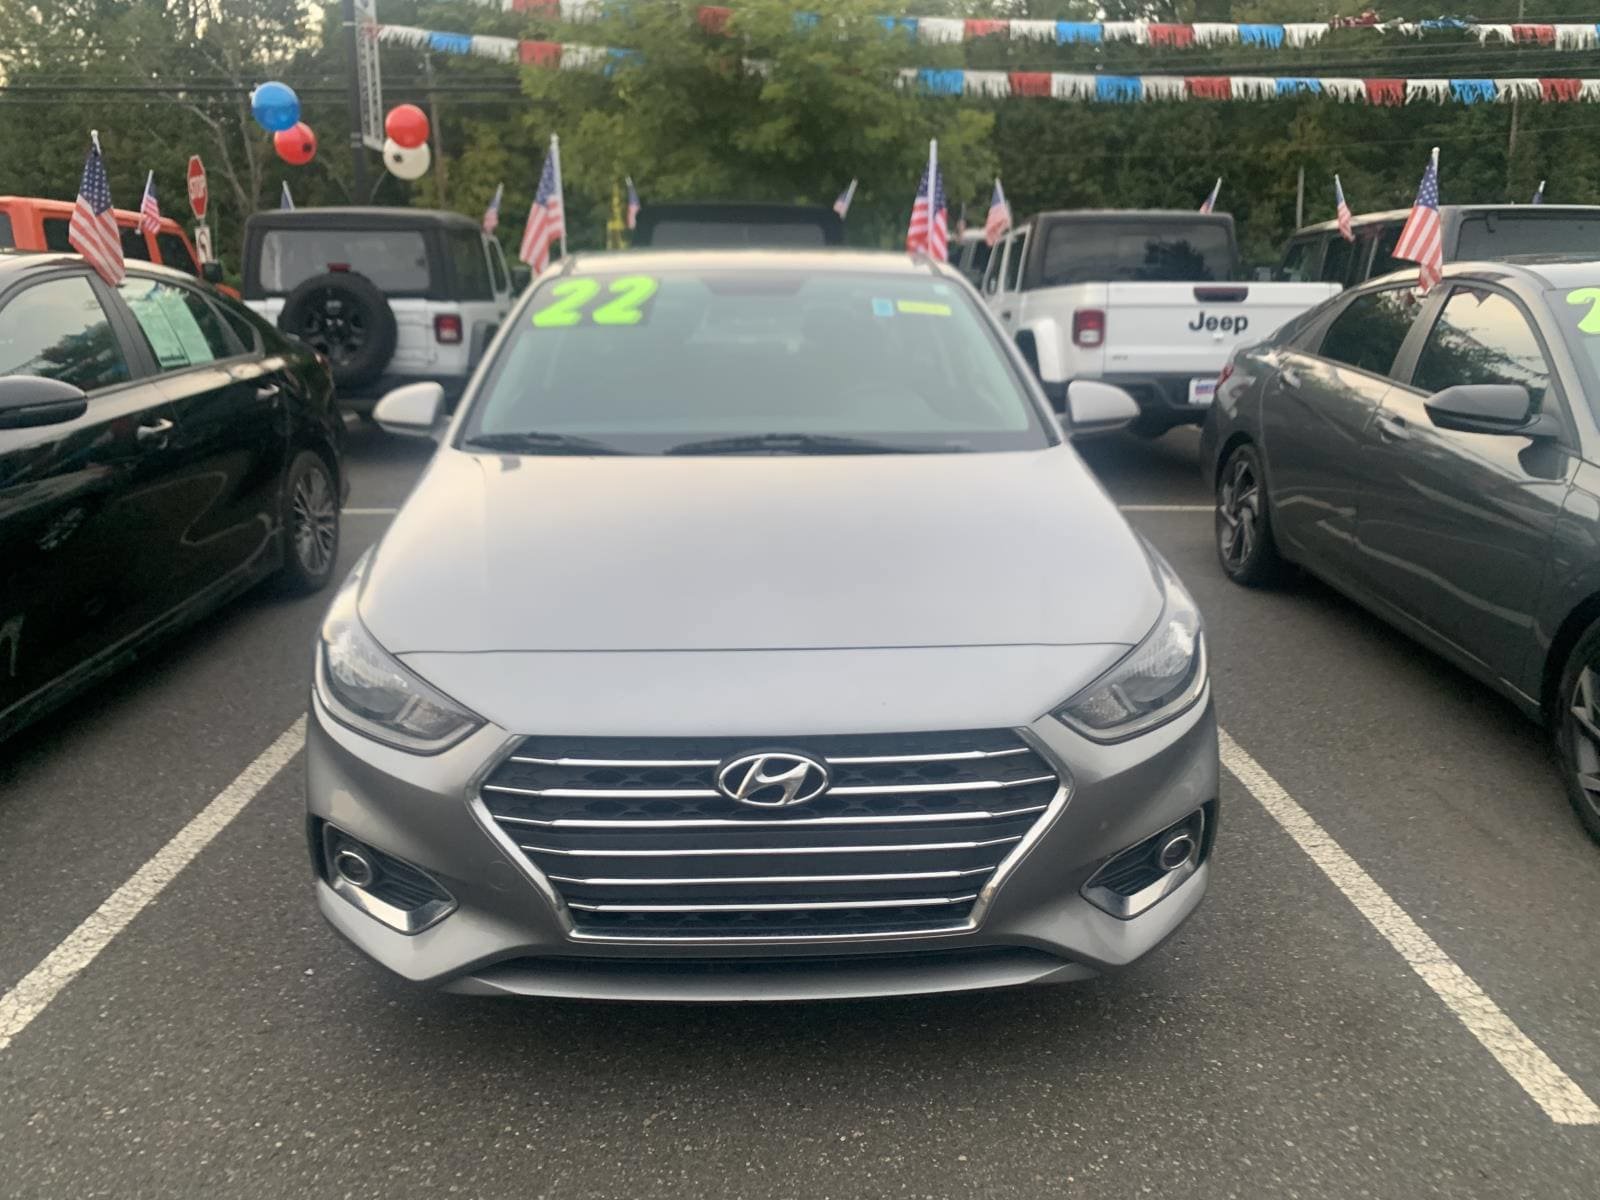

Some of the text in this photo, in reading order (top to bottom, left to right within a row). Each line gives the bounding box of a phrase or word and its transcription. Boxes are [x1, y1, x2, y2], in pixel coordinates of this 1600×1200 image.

[189, 175, 207, 199] STOP
[532, 275, 658, 327] 22
[1189, 311, 1248, 334] Jeep
